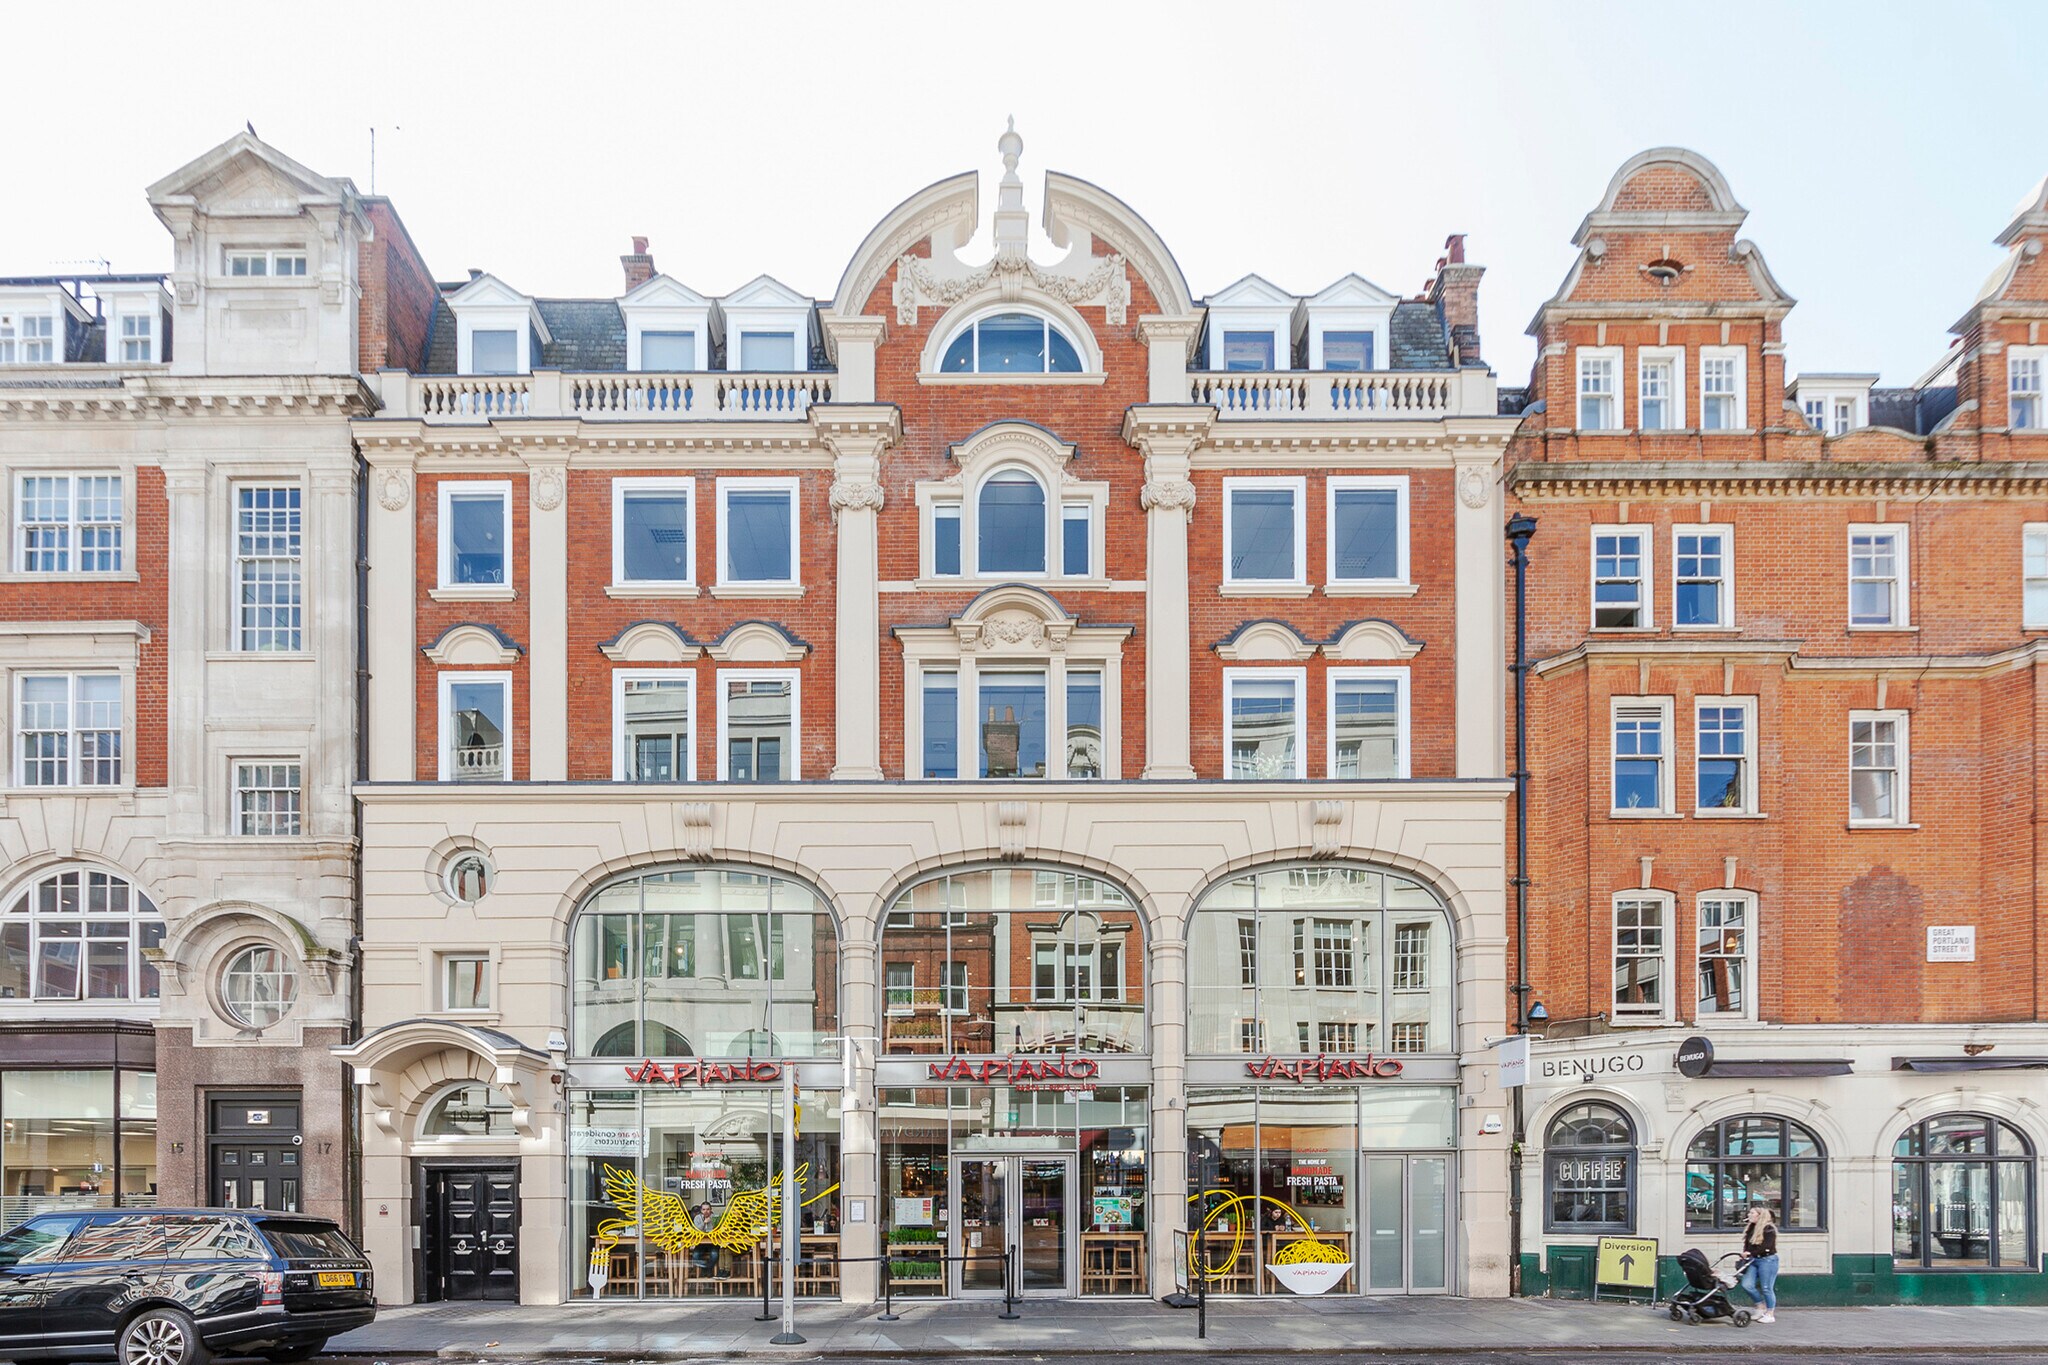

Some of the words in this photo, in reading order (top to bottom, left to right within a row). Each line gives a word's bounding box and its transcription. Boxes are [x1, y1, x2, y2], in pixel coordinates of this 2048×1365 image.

[1932, 928, 1956, 936] GREAT
[1932, 937, 1970, 945] PORTLAND
[1932, 945, 1958, 953] STREET
[1679, 1051, 1705, 1063] BENUGO
[929, 1052, 1098, 1085] VAPIANO
[1247, 1053, 1403, 1084] VAPIANO
[1500, 1058, 1525, 1069] VAPIANO
[1542, 1054, 1644, 1078] BENUGO
[625, 1056, 782, 1088] VAPIANO
[170, 1142, 184, 1154] 15
[317, 1142, 332, 1154] 17
[1291, 1166, 1333, 1175] HANDMADE
[1560, 1160, 1621, 1181] COFFEE
[680, 1180, 706, 1190] FRESH
[708, 1180, 732, 1189] PASTA
[1286, 1176, 1312, 1186] FRESH
[1314, 1176, 1338, 1186] PASTA
[1604, 1242, 1653, 1252] Diversion
